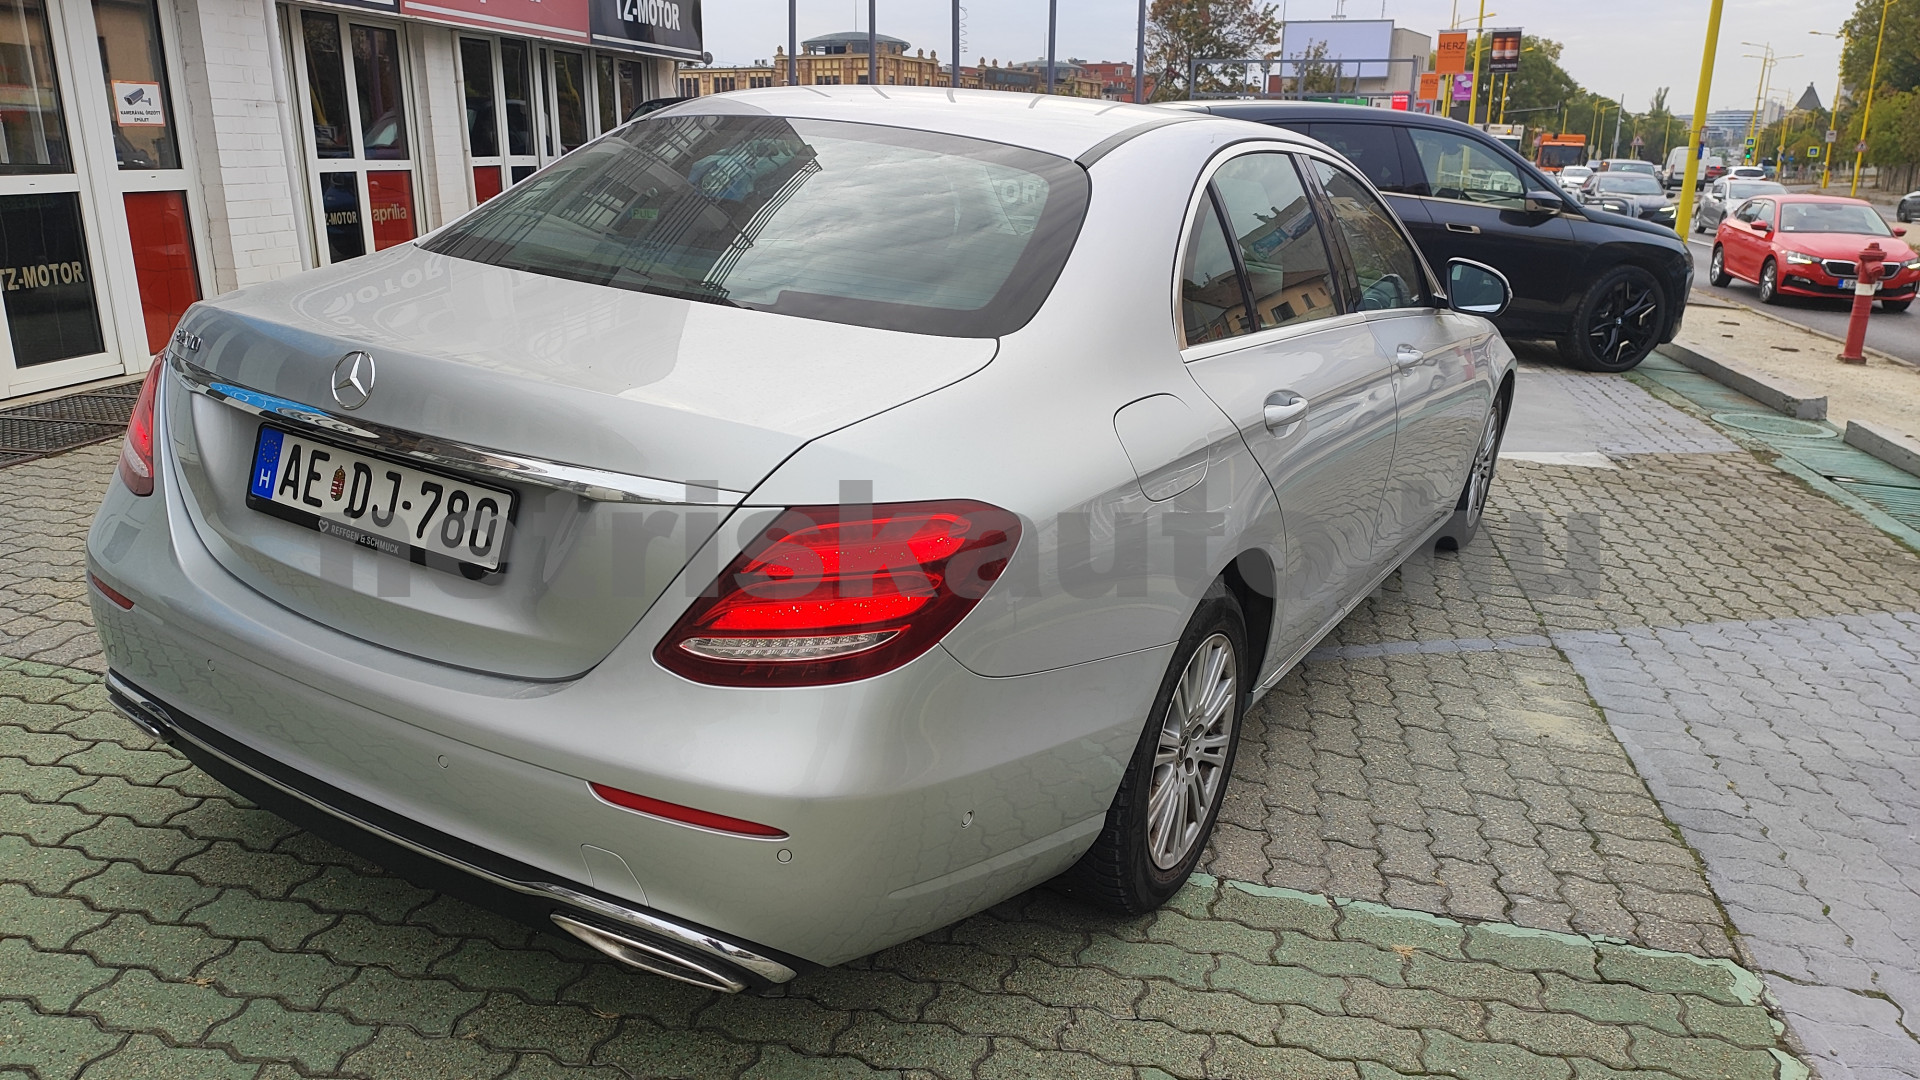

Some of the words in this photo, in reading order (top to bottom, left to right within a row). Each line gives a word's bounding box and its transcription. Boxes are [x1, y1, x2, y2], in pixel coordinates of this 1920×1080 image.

[1439, 41, 1465, 50] HERZ
[325, 211, 358, 226] Z-MOTOR
[372, 203, 407, 225] aprilia
[0, 261, 85, 291] TZ-MOTOR
[258, 468, 271, 489] H
[278, 444, 331, 508] AE
[331, 524, 360, 541] REFFGEN
[366, 536, 399, 555] SCHMUCK
